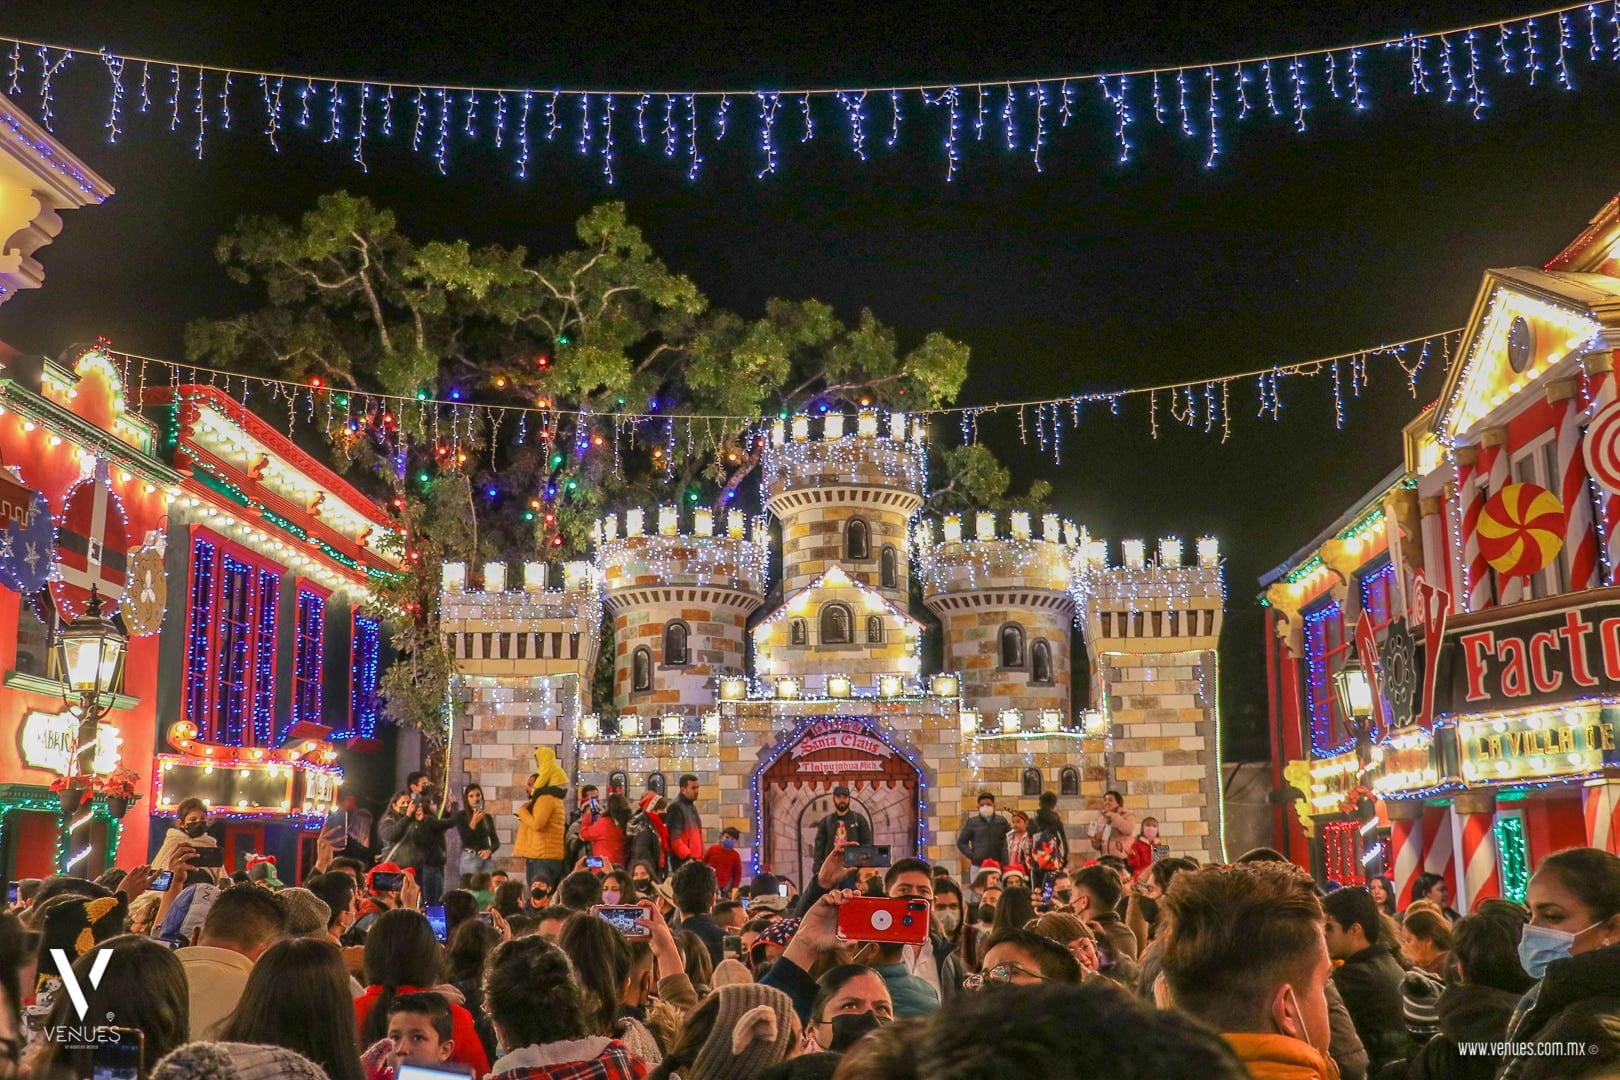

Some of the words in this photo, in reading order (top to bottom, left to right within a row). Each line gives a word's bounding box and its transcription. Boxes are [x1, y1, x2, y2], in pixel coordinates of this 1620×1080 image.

[801, 734, 837, 754] Santa
[841, 734, 879, 753] Claus
[1506, 725, 1575, 758] VILLA
